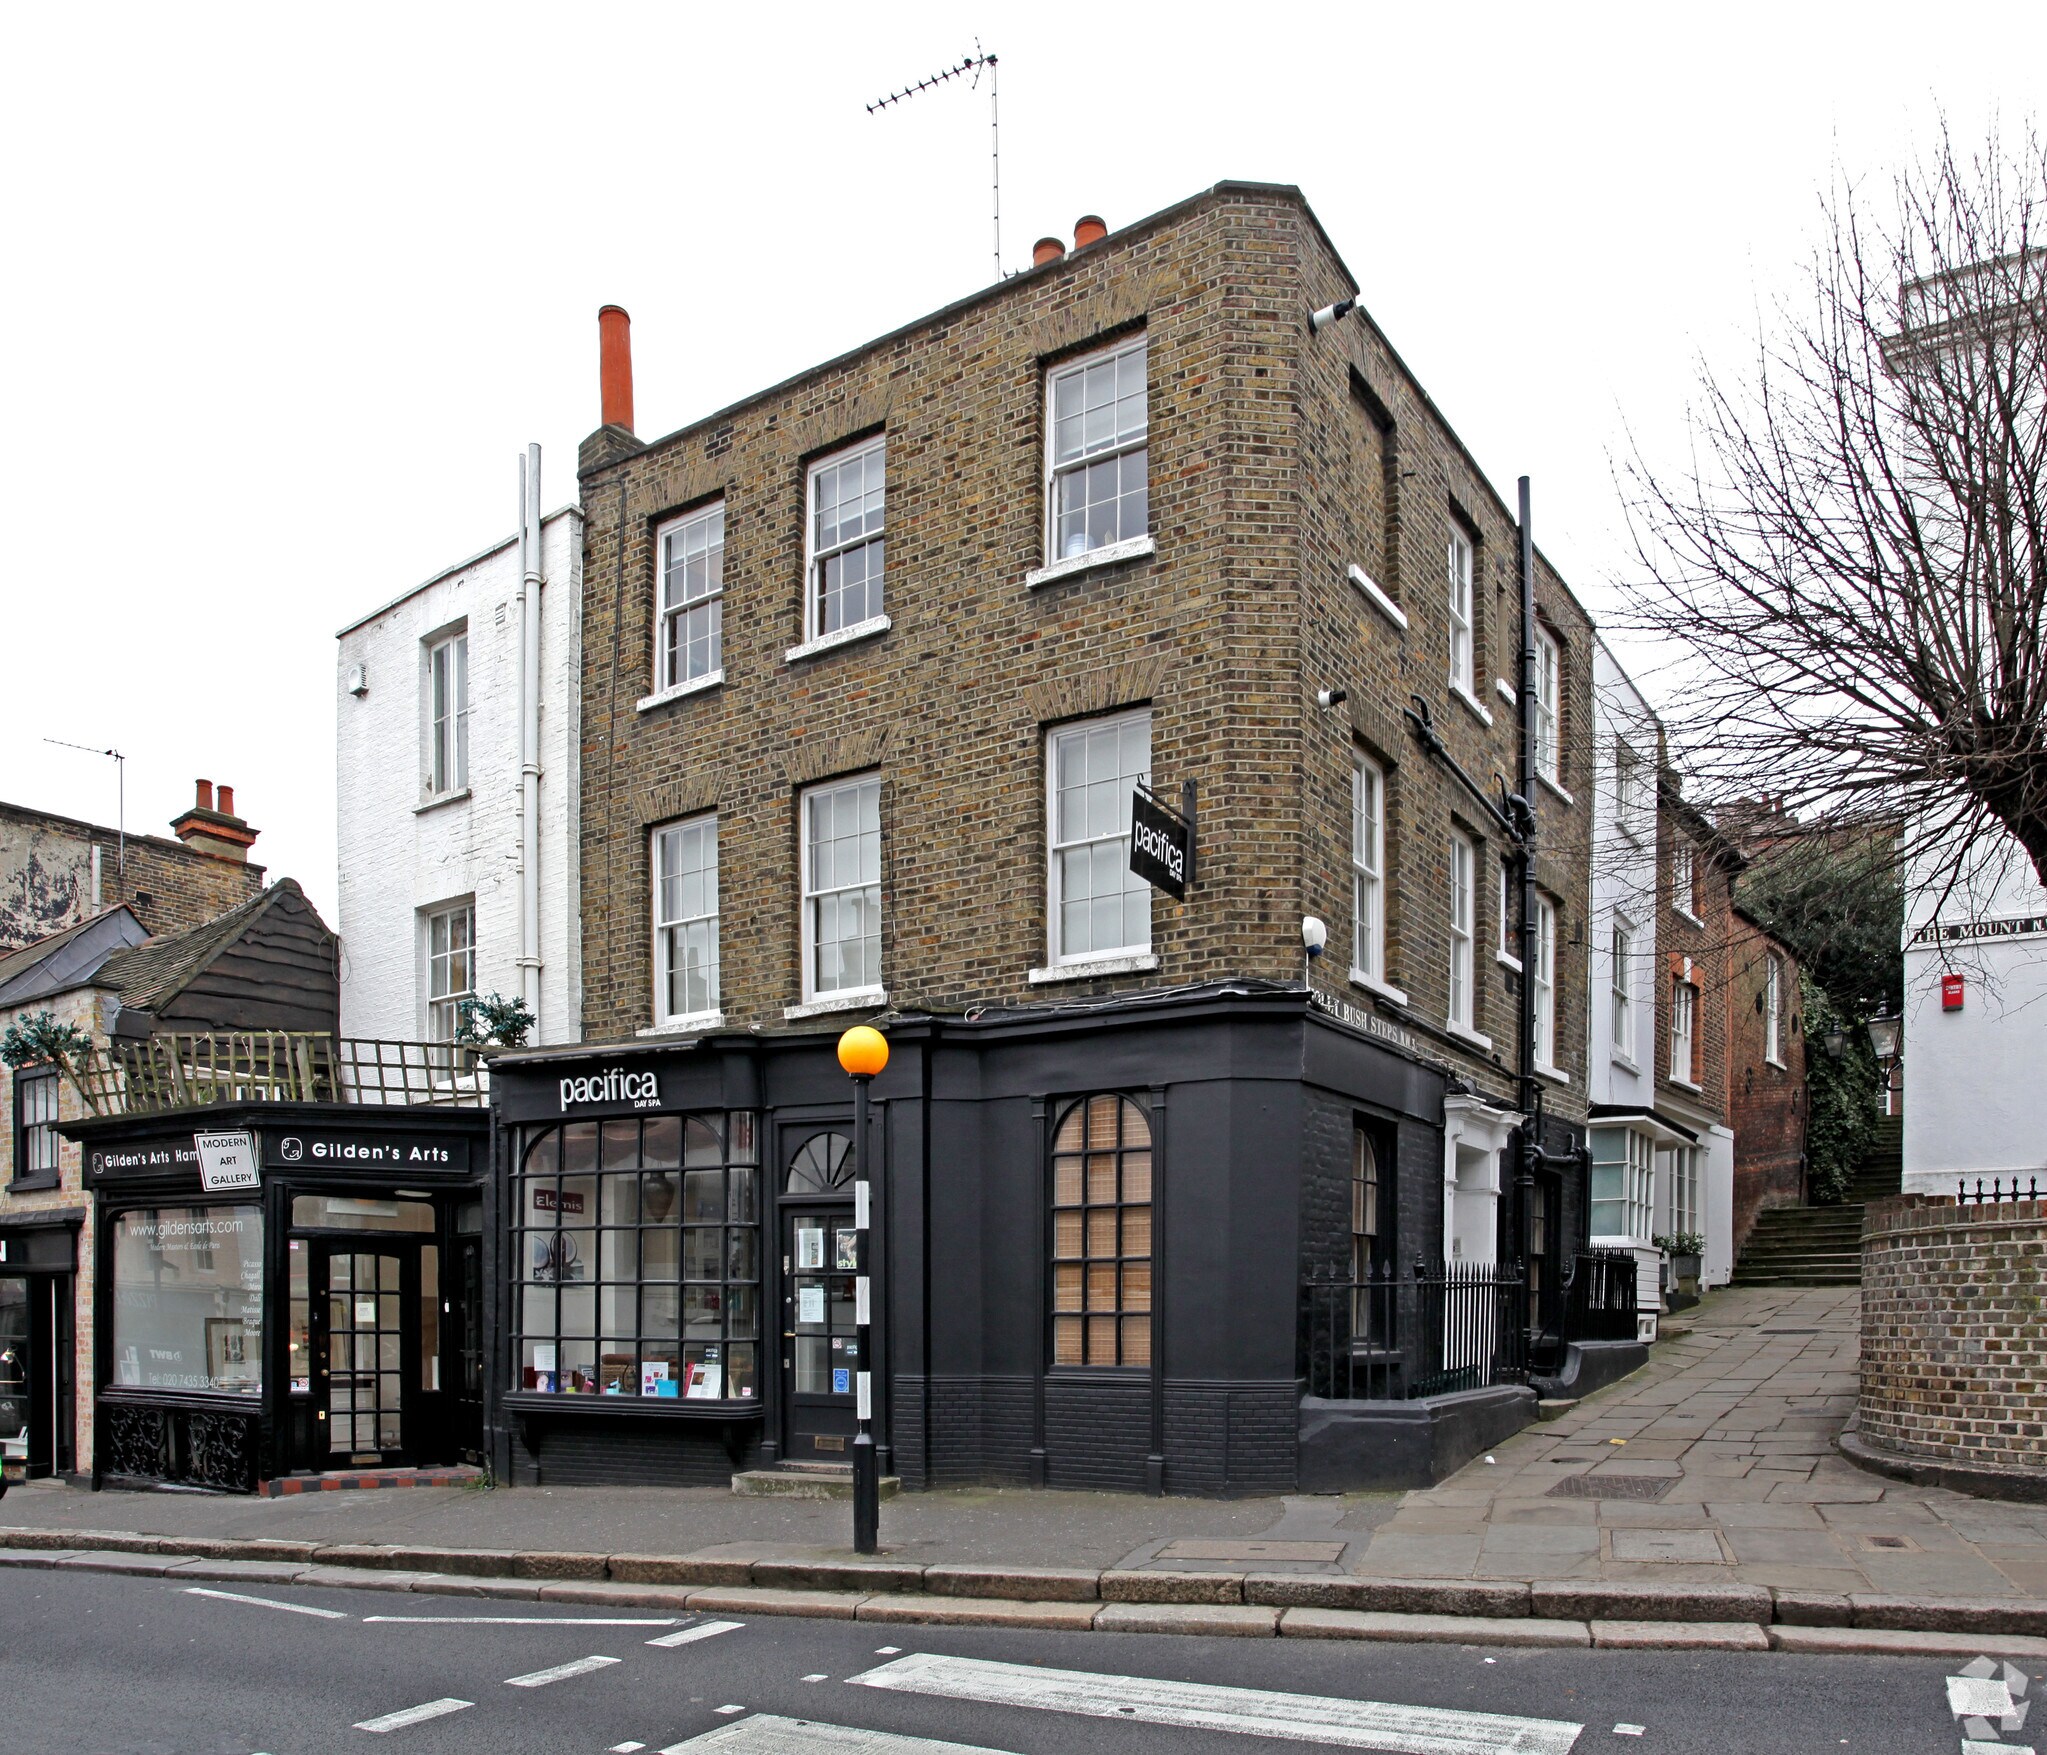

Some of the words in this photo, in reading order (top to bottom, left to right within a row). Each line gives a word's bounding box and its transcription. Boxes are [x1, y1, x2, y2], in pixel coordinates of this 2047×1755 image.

[1135, 820, 1183, 874] pacifica
[1915, 926, 1950, 943] THE
[1959, 920, 2024, 939] MOUNT
[1343, 1003, 1368, 1030] BUSH
[1370, 1016, 1398, 1042] STEPS
[560, 1067, 658, 1112] pacifica
[634, 1100, 647, 1108] DAY
[648, 1099, 661, 1107] SPA
[202, 1137, 247, 1149] MODERN
[105, 1152, 146, 1168] Gilden's
[150, 1151, 170, 1164] Arts
[219, 1156, 237, 1166] ART
[312, 1143, 400, 1160] Gilden's
[409, 1147, 449, 1162] Arts
[211, 1173, 252, 1185] GALLERY
[130, 1220, 243, 1239] www.gildensarts.com
[163, 1373, 177, 1385] 020
[179, 1375, 198, 1387] 7435
[200, 1377, 219, 1389] 3340
